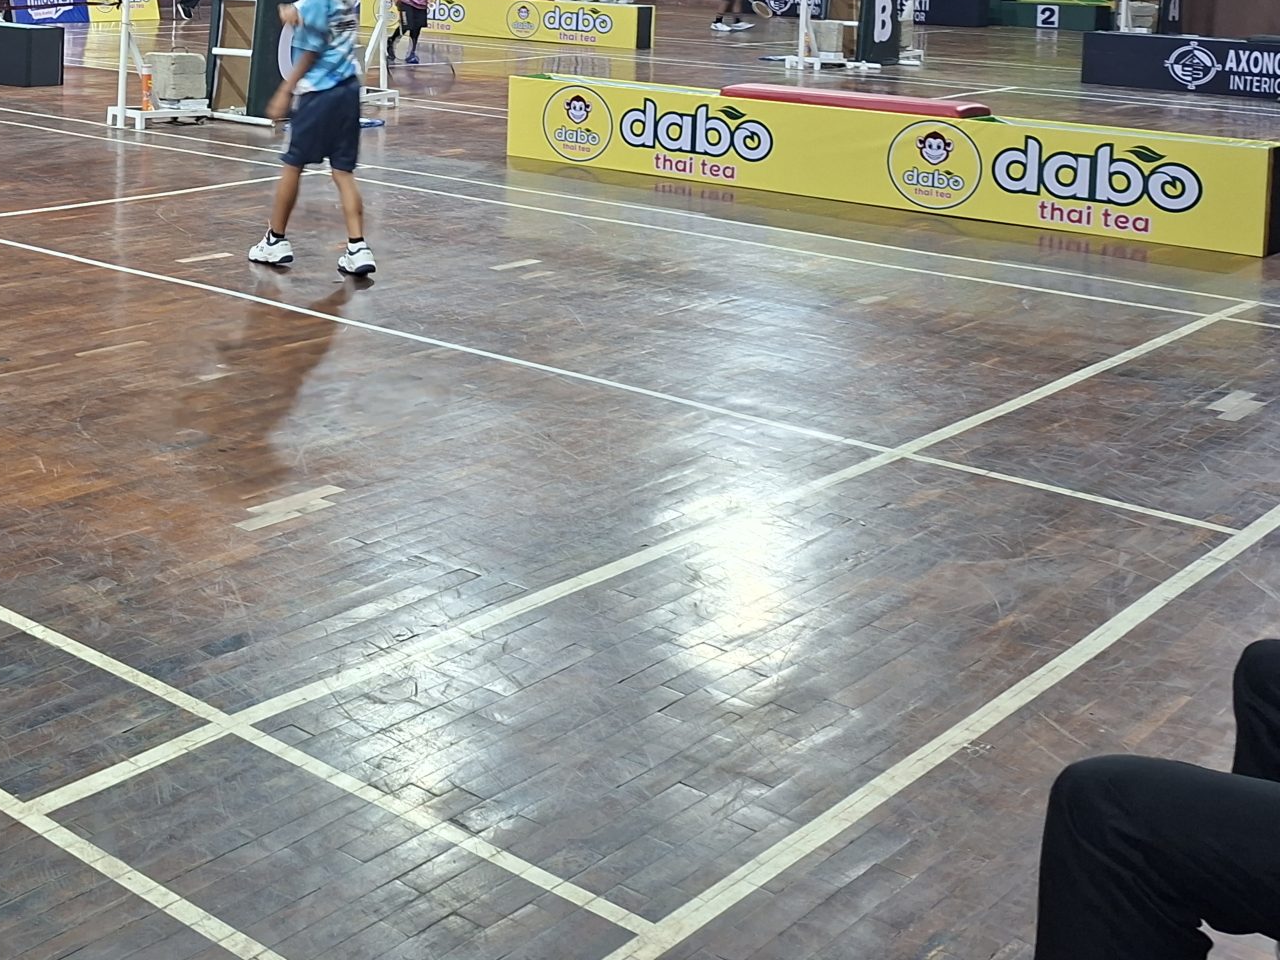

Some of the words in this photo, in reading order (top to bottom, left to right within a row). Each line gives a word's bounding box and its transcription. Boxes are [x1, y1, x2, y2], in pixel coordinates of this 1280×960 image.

[543, 5, 613, 34] dabo
[1040, 7, 1056, 26] 2
[559, 32, 578, 41] thai
[580, 34, 597, 43] tea
[554, 125, 600, 146] dabo
[620, 97, 774, 162] dabo
[654, 152, 693, 174] thai
[701, 159, 736, 180] tea
[902, 166, 965, 191] dabo
[992, 135, 1203, 213] dabo
[914, 188, 933, 196] thai
[935, 190, 952, 199] tea
[1038, 200, 1092, 226] thai
[1102, 208, 1150, 233] tea
